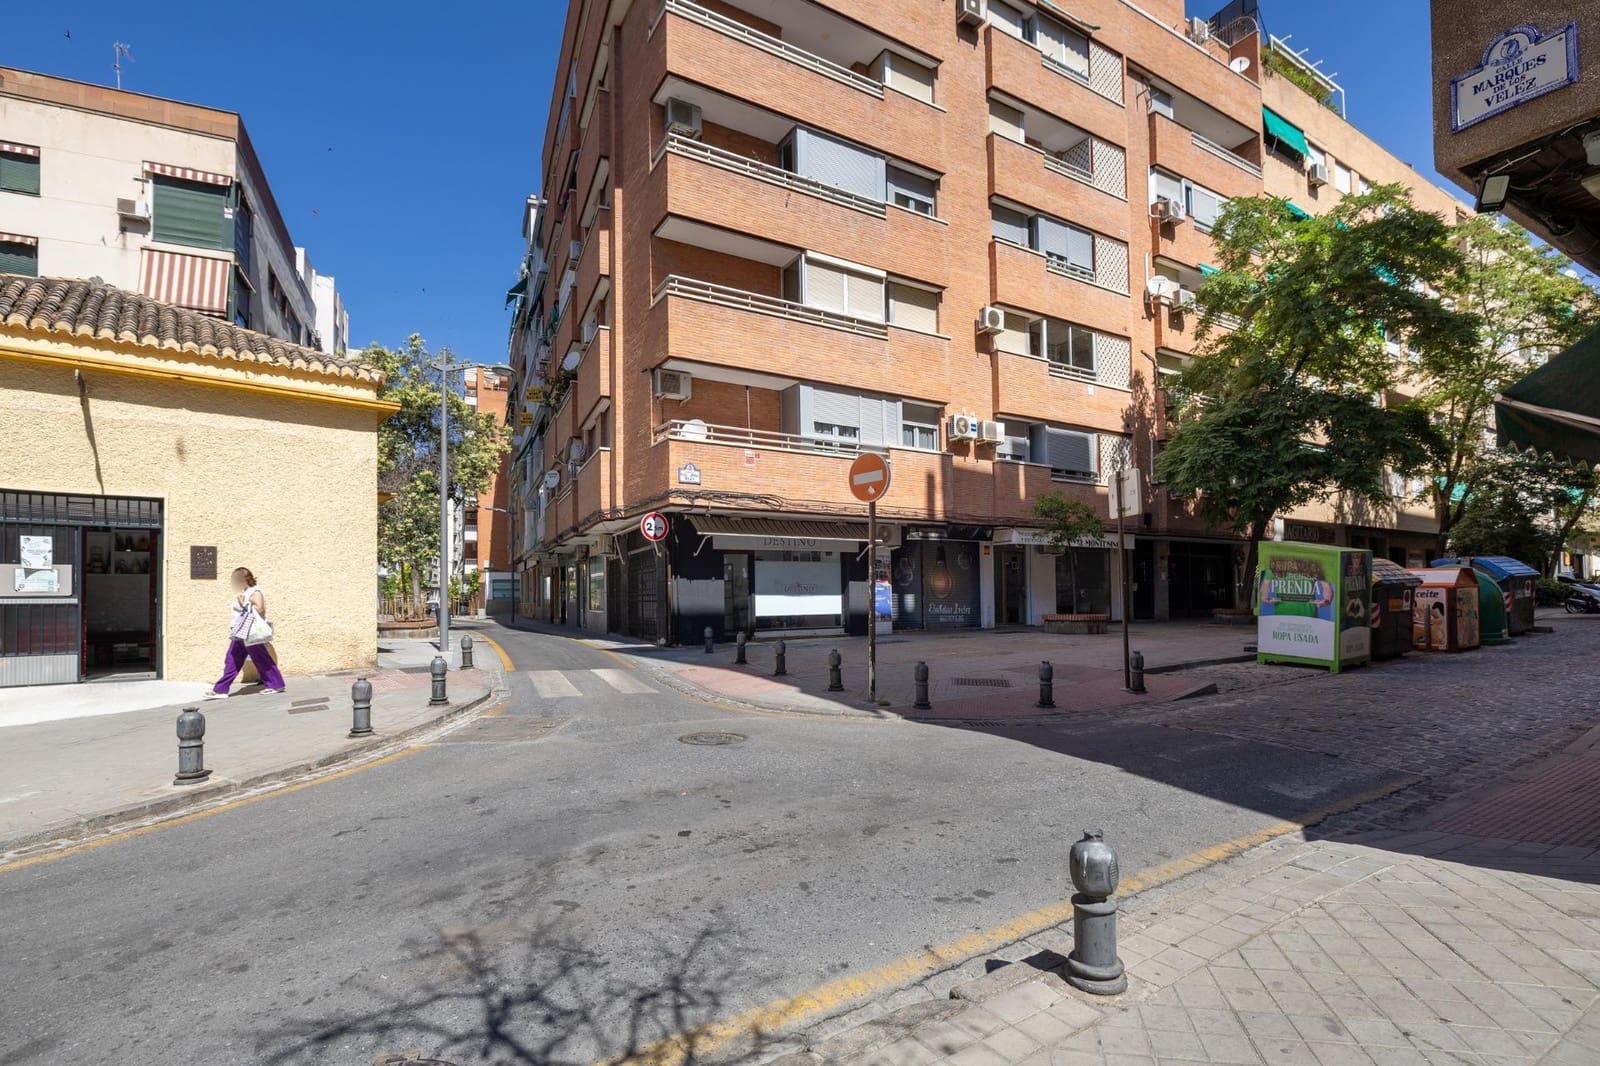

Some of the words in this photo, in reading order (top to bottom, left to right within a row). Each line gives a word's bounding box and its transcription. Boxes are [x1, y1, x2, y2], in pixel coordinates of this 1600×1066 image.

[1496, 57, 1524, 74] CALLE
[1472, 54, 1547, 96] MARQUES
[1484, 77, 1537, 107] VELEZ
[1493, 83, 1506, 94] DE
[1509, 74, 1527, 87] LOS
[763, 536, 816, 547] DESTINO
[1271, 579, 1321, 595] PRENDA
[1415, 589, 1440, 599] ceite
[1272, 631, 1292, 642] ROPA
[1294, 633, 1319, 645] USADA
